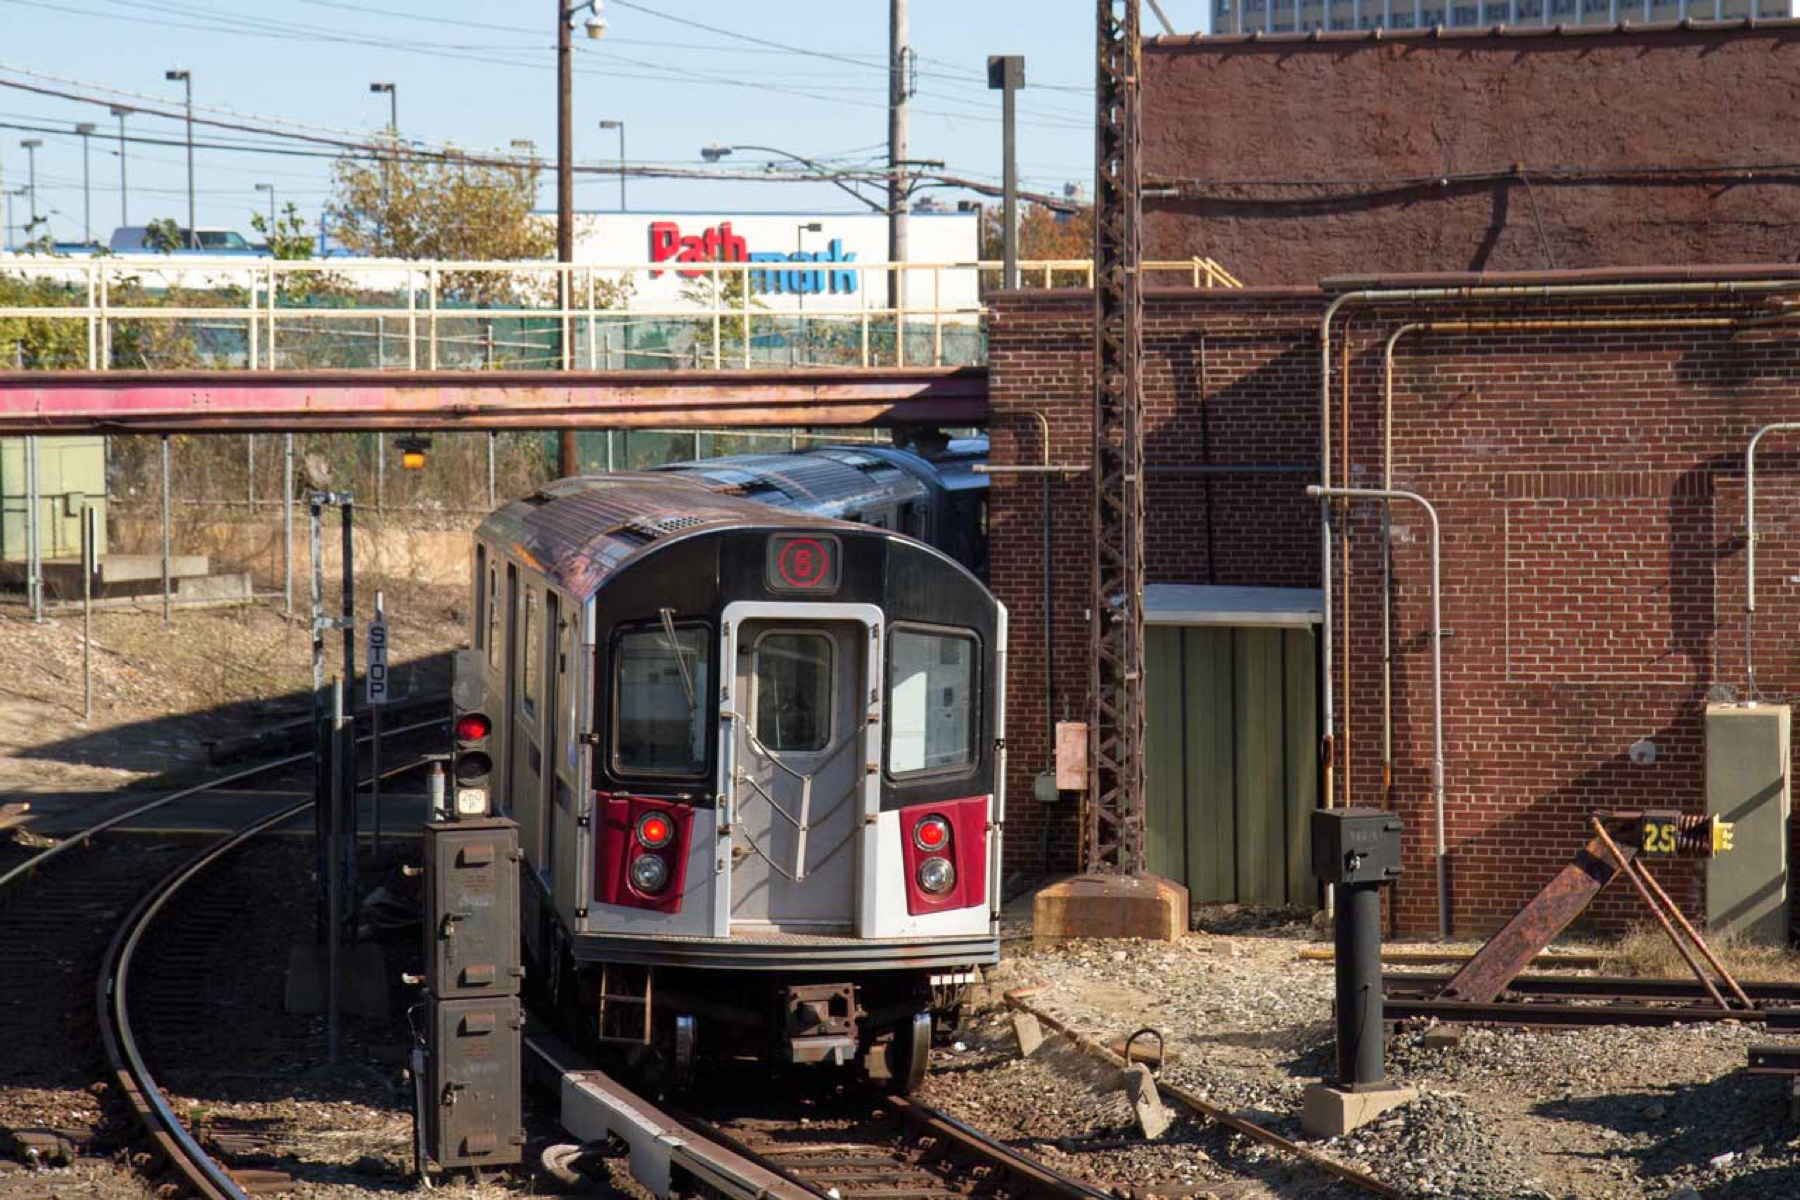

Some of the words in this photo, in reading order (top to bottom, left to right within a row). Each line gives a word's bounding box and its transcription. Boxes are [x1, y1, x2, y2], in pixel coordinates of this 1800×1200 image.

[794, 548, 813, 578] 6
[369, 626, 386, 699] STOP
[1643, 823, 1677, 852] 25
